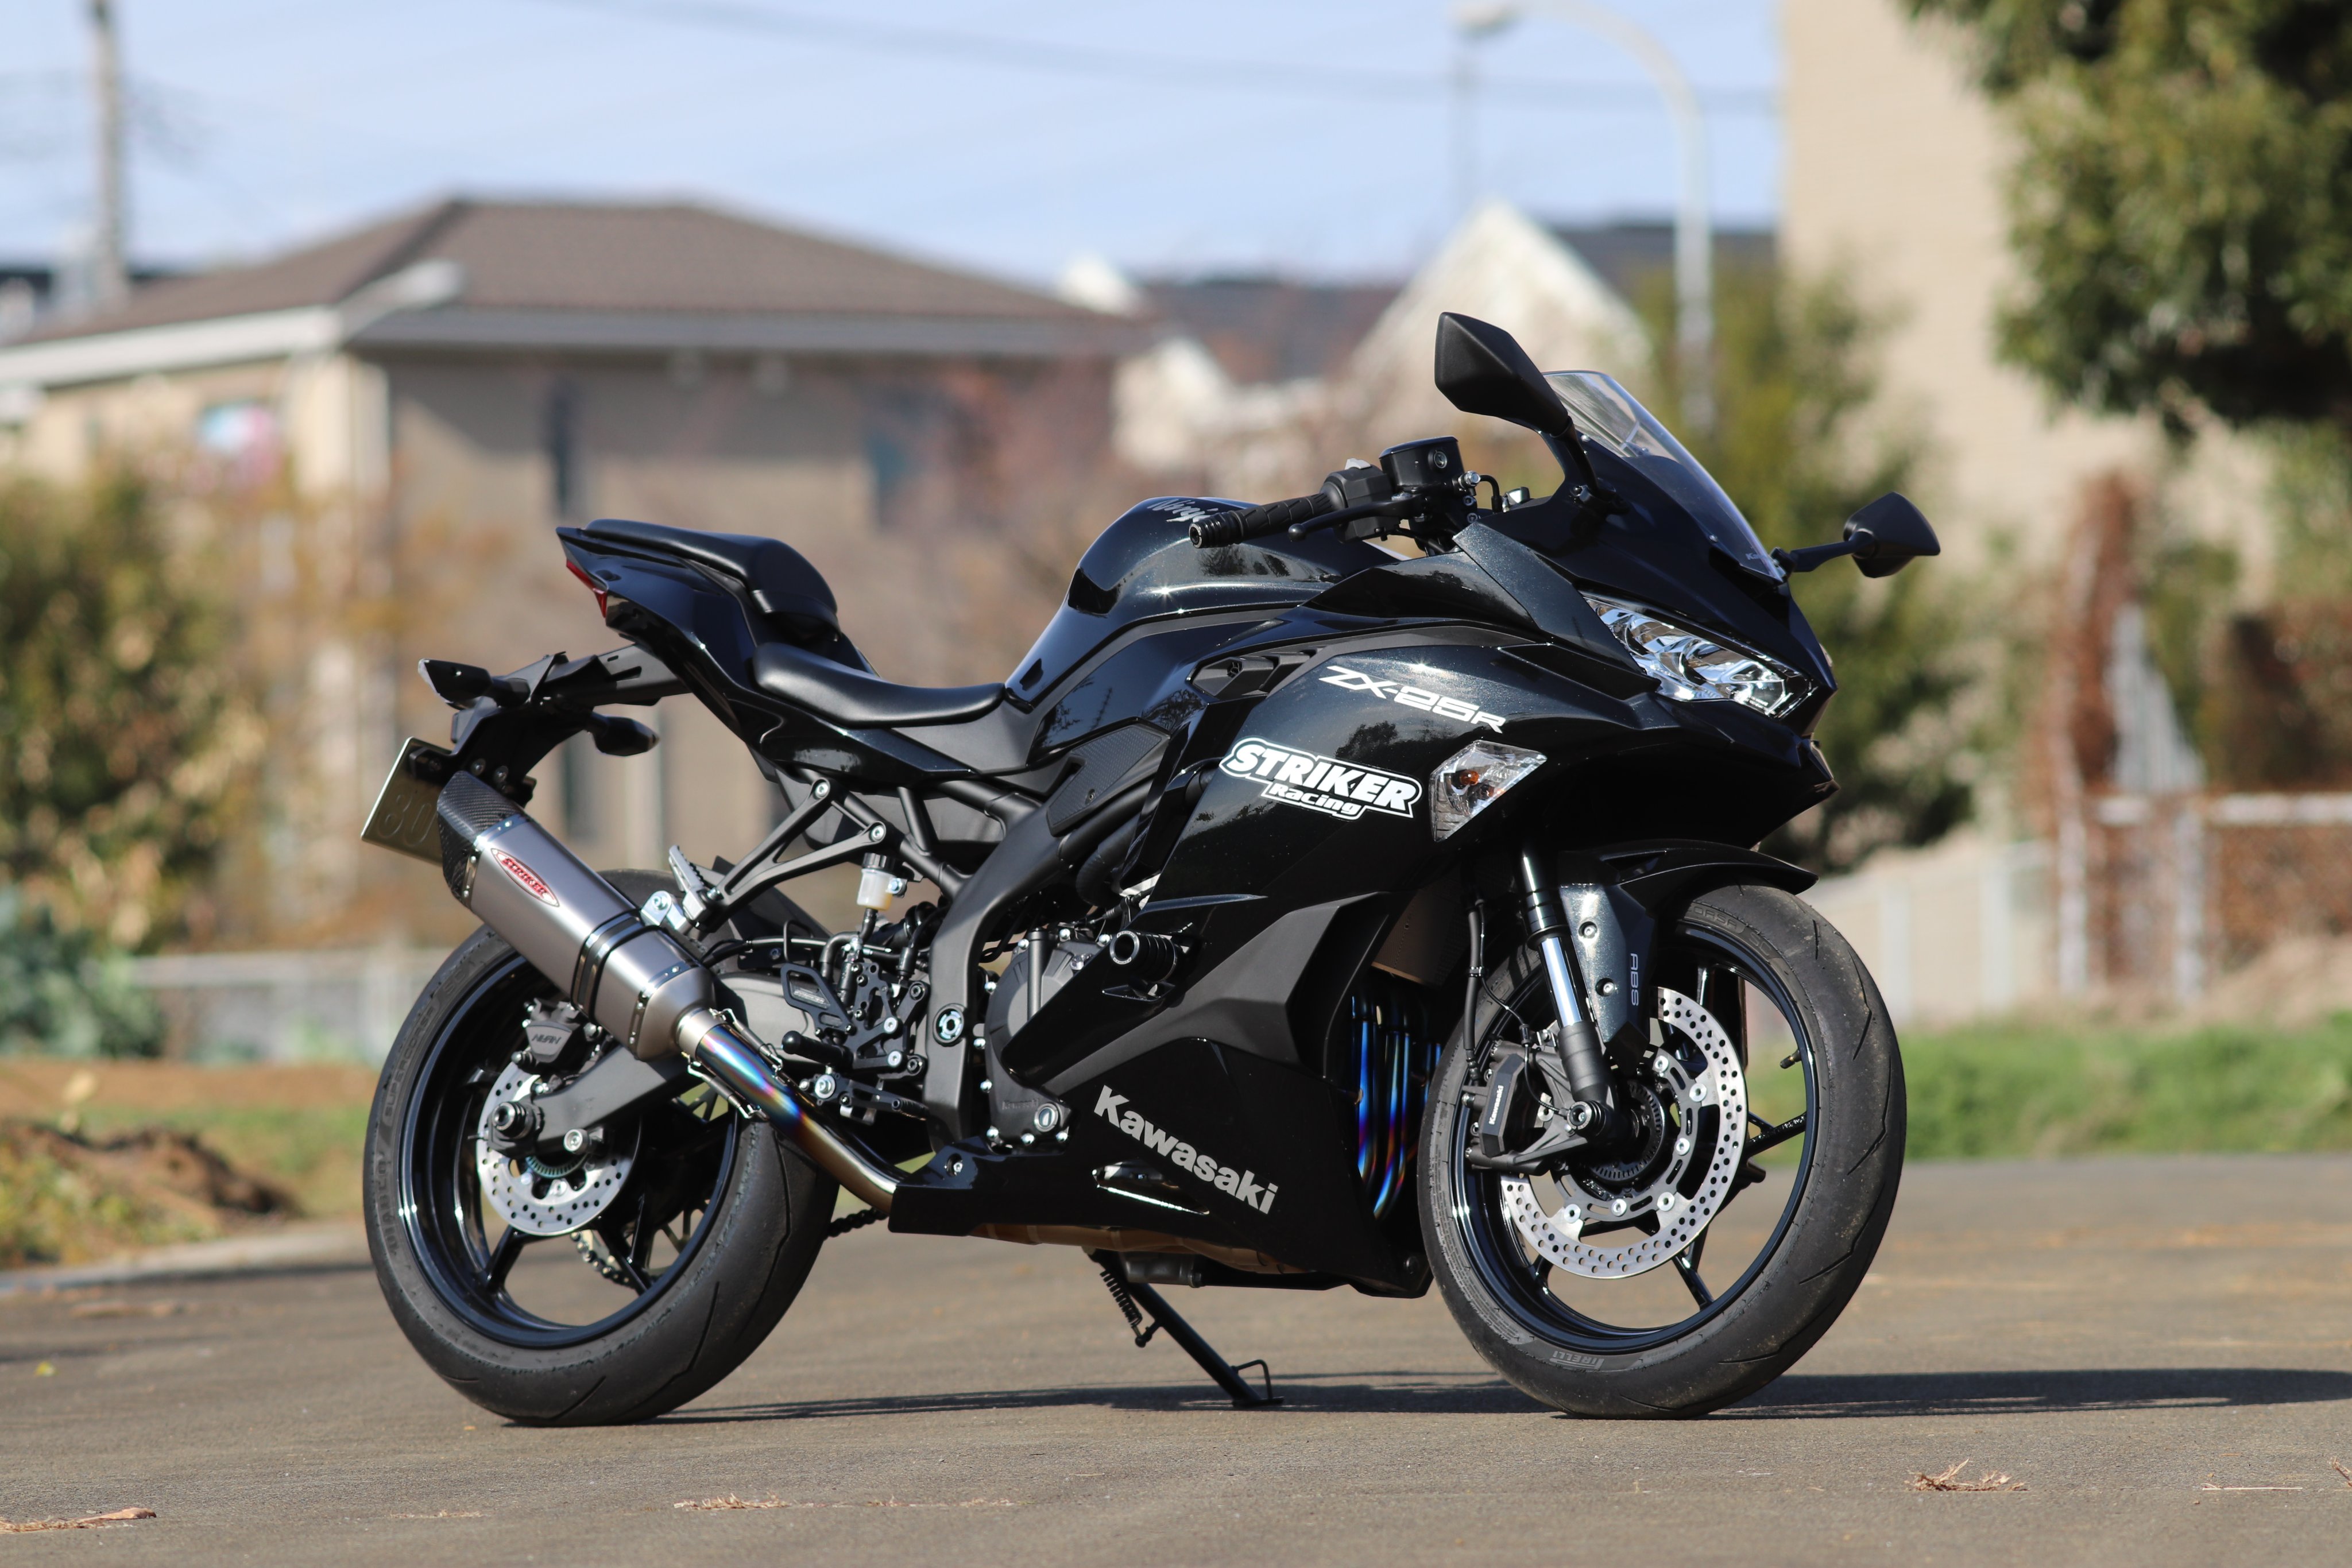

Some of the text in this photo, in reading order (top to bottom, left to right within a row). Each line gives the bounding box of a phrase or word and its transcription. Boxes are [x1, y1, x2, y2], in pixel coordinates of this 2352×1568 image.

[1319, 665, 1506, 733] ZX-25R
[1226, 743, 1417, 811] STRIKER
[1267, 783, 1362, 816] Racing
[1630, 953, 1639, 1006] ABS
[1093, 1085, 1279, 1215] Kawasaki
[1550, 1350, 1606, 1371] PIRELLI
